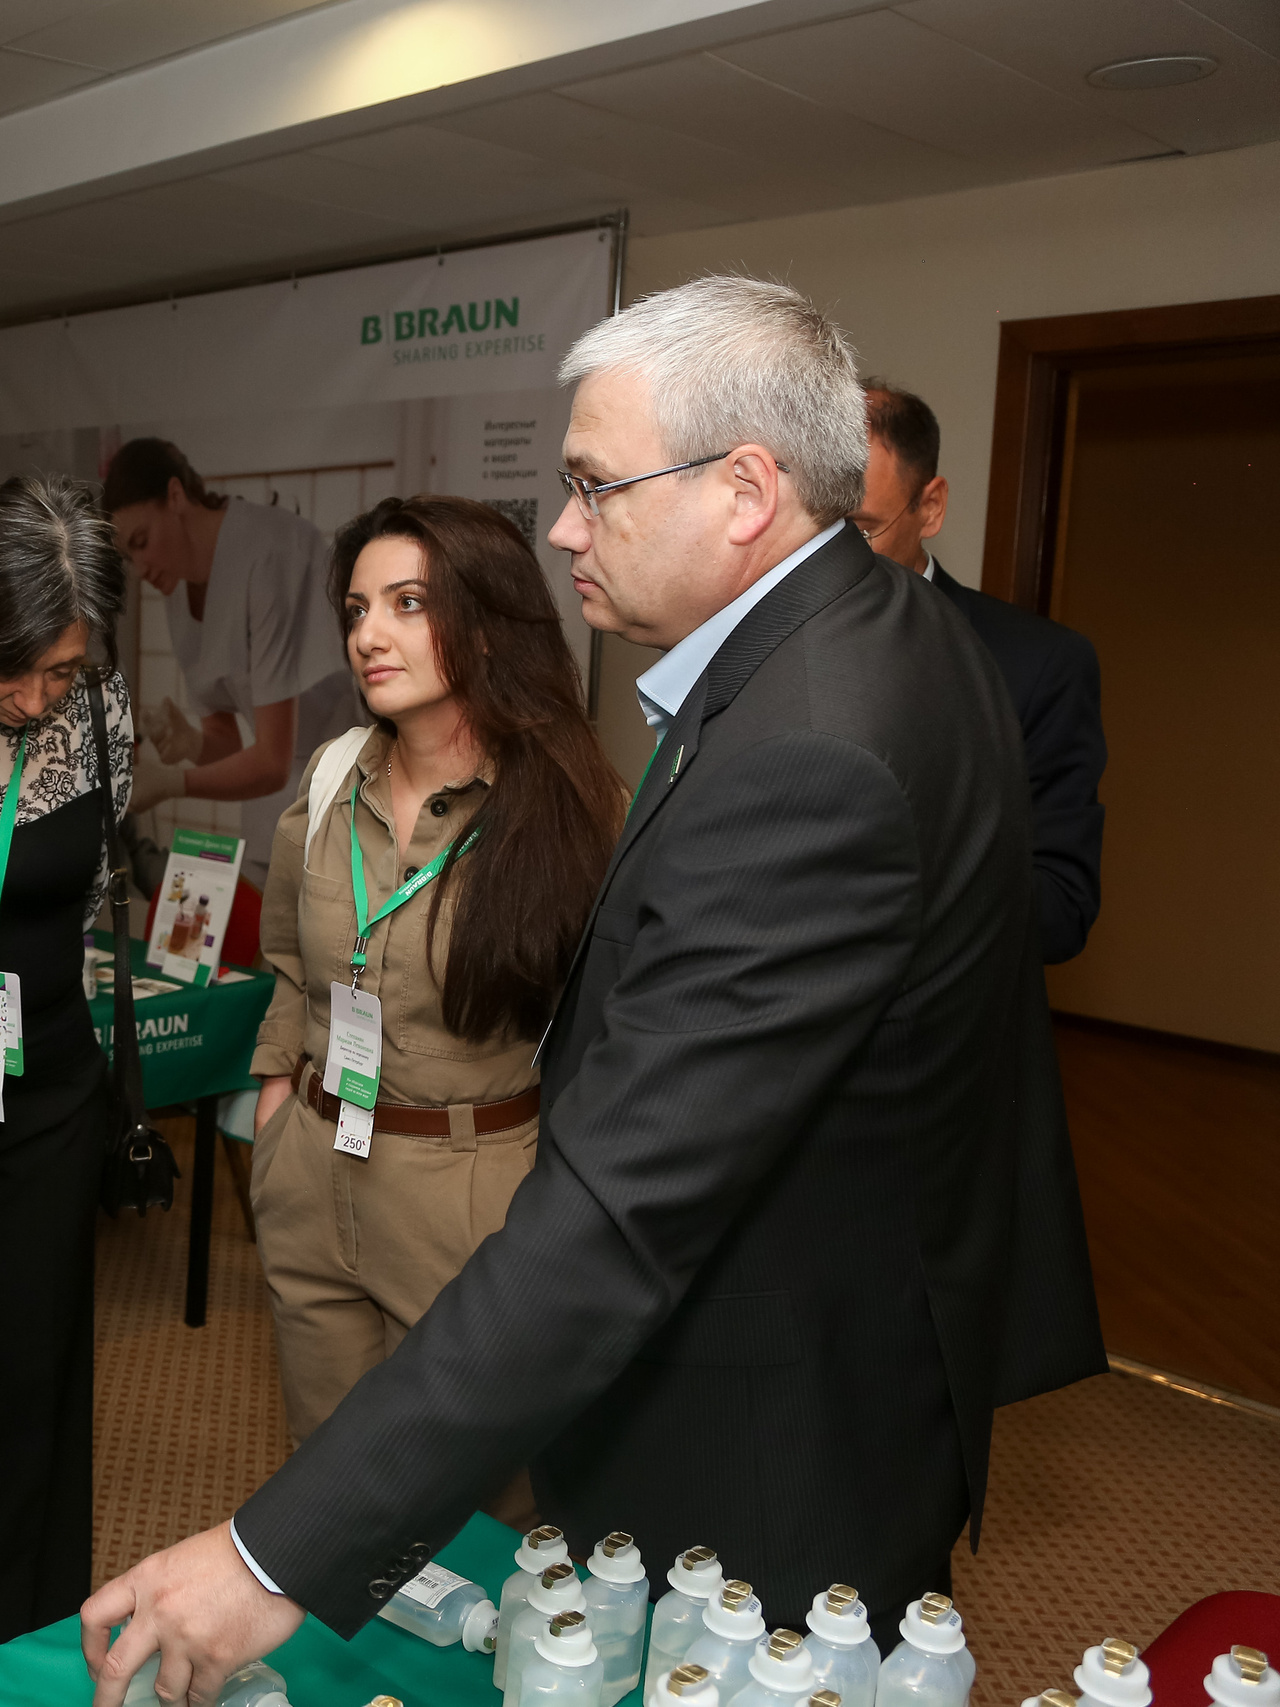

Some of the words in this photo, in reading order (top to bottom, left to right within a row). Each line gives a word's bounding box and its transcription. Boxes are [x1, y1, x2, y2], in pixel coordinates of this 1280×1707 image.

[361, 315, 382, 345] B
[394, 296, 520, 341] BRAUN
[393, 343, 458, 365] SHARING
[465, 333, 545, 359] EXPERTISE
[405, 875, 427, 897] BRAUN
[156, 1034, 203, 1053] EXPERTISE
[343, 1136, 362, 1151] 250
